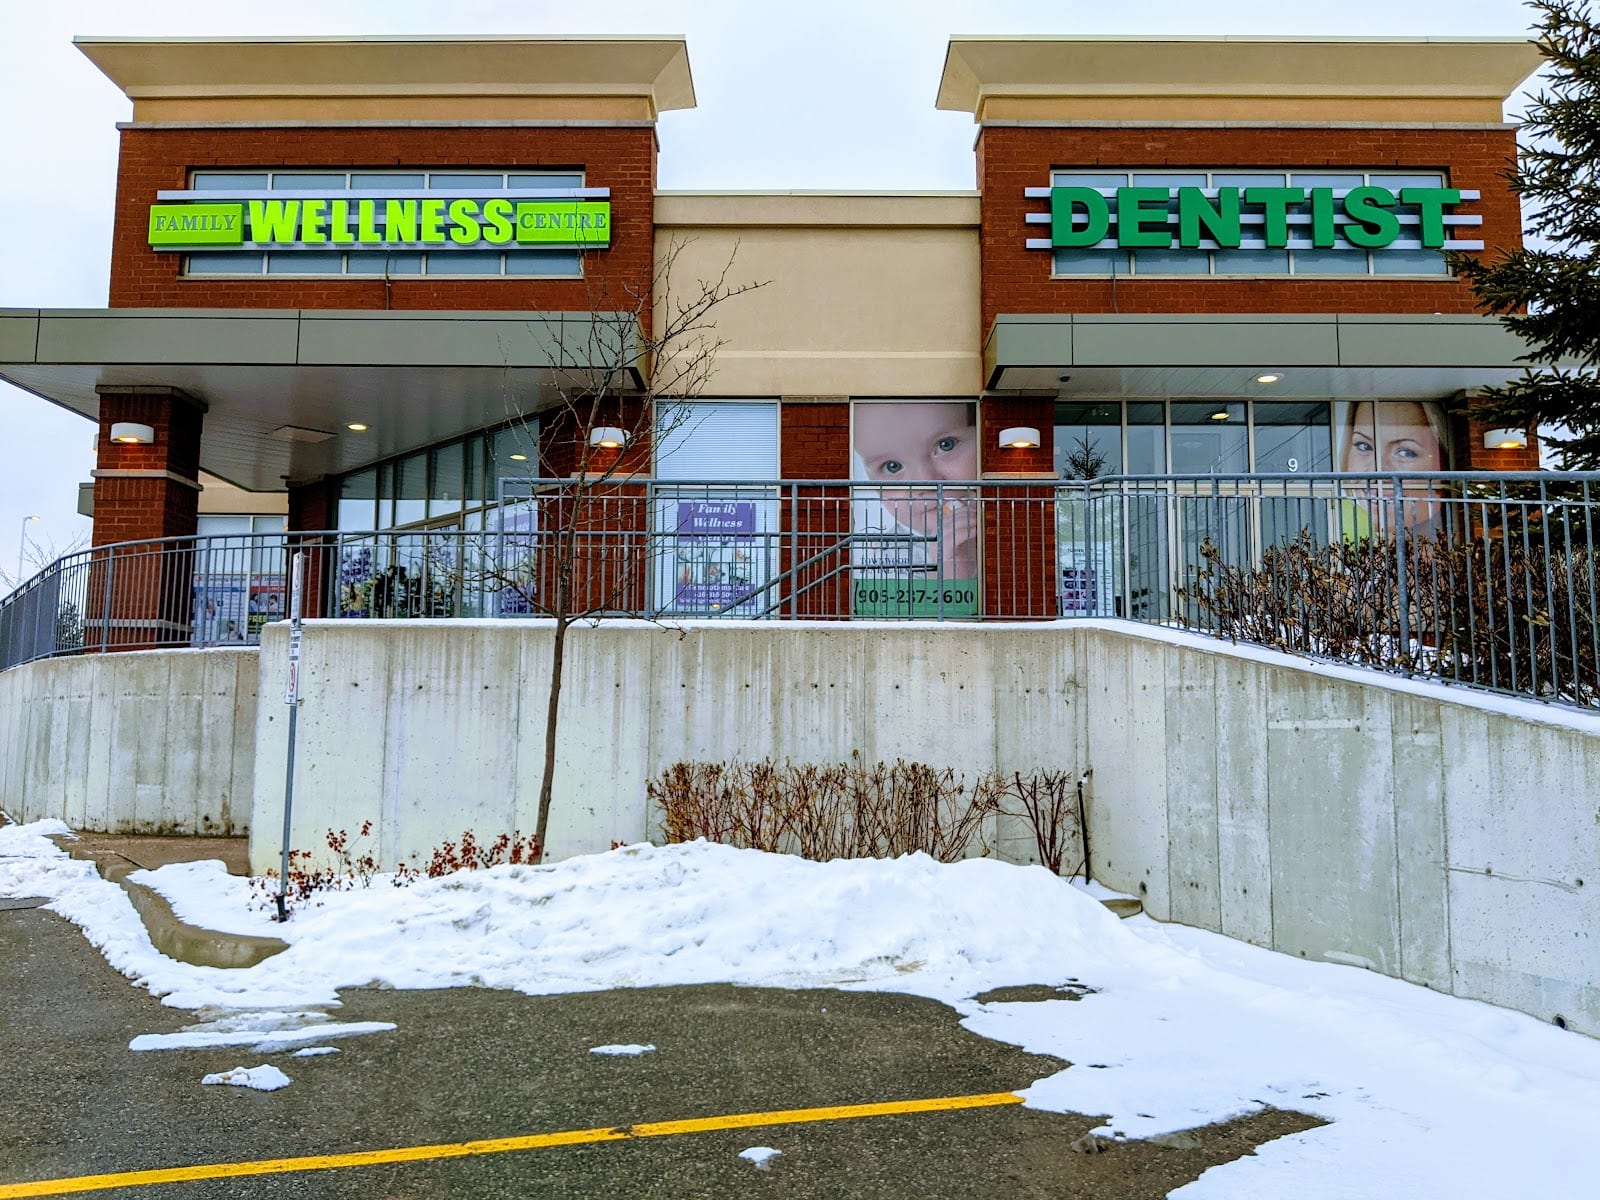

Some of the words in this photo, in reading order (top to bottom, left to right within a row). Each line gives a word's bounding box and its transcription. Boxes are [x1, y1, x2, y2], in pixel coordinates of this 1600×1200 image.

[154, 213, 235, 232] FAMILY
[248, 199, 515, 246] WELLNESS
[519, 212, 607, 230] CENTRE
[1050, 186, 1461, 250] DENTIST
[1287, 457, 1298, 472] 9
[698, 503, 737, 515] Family
[693, 517, 743, 528] Wellness
[858, 589, 974, 604] 905-237-2600
